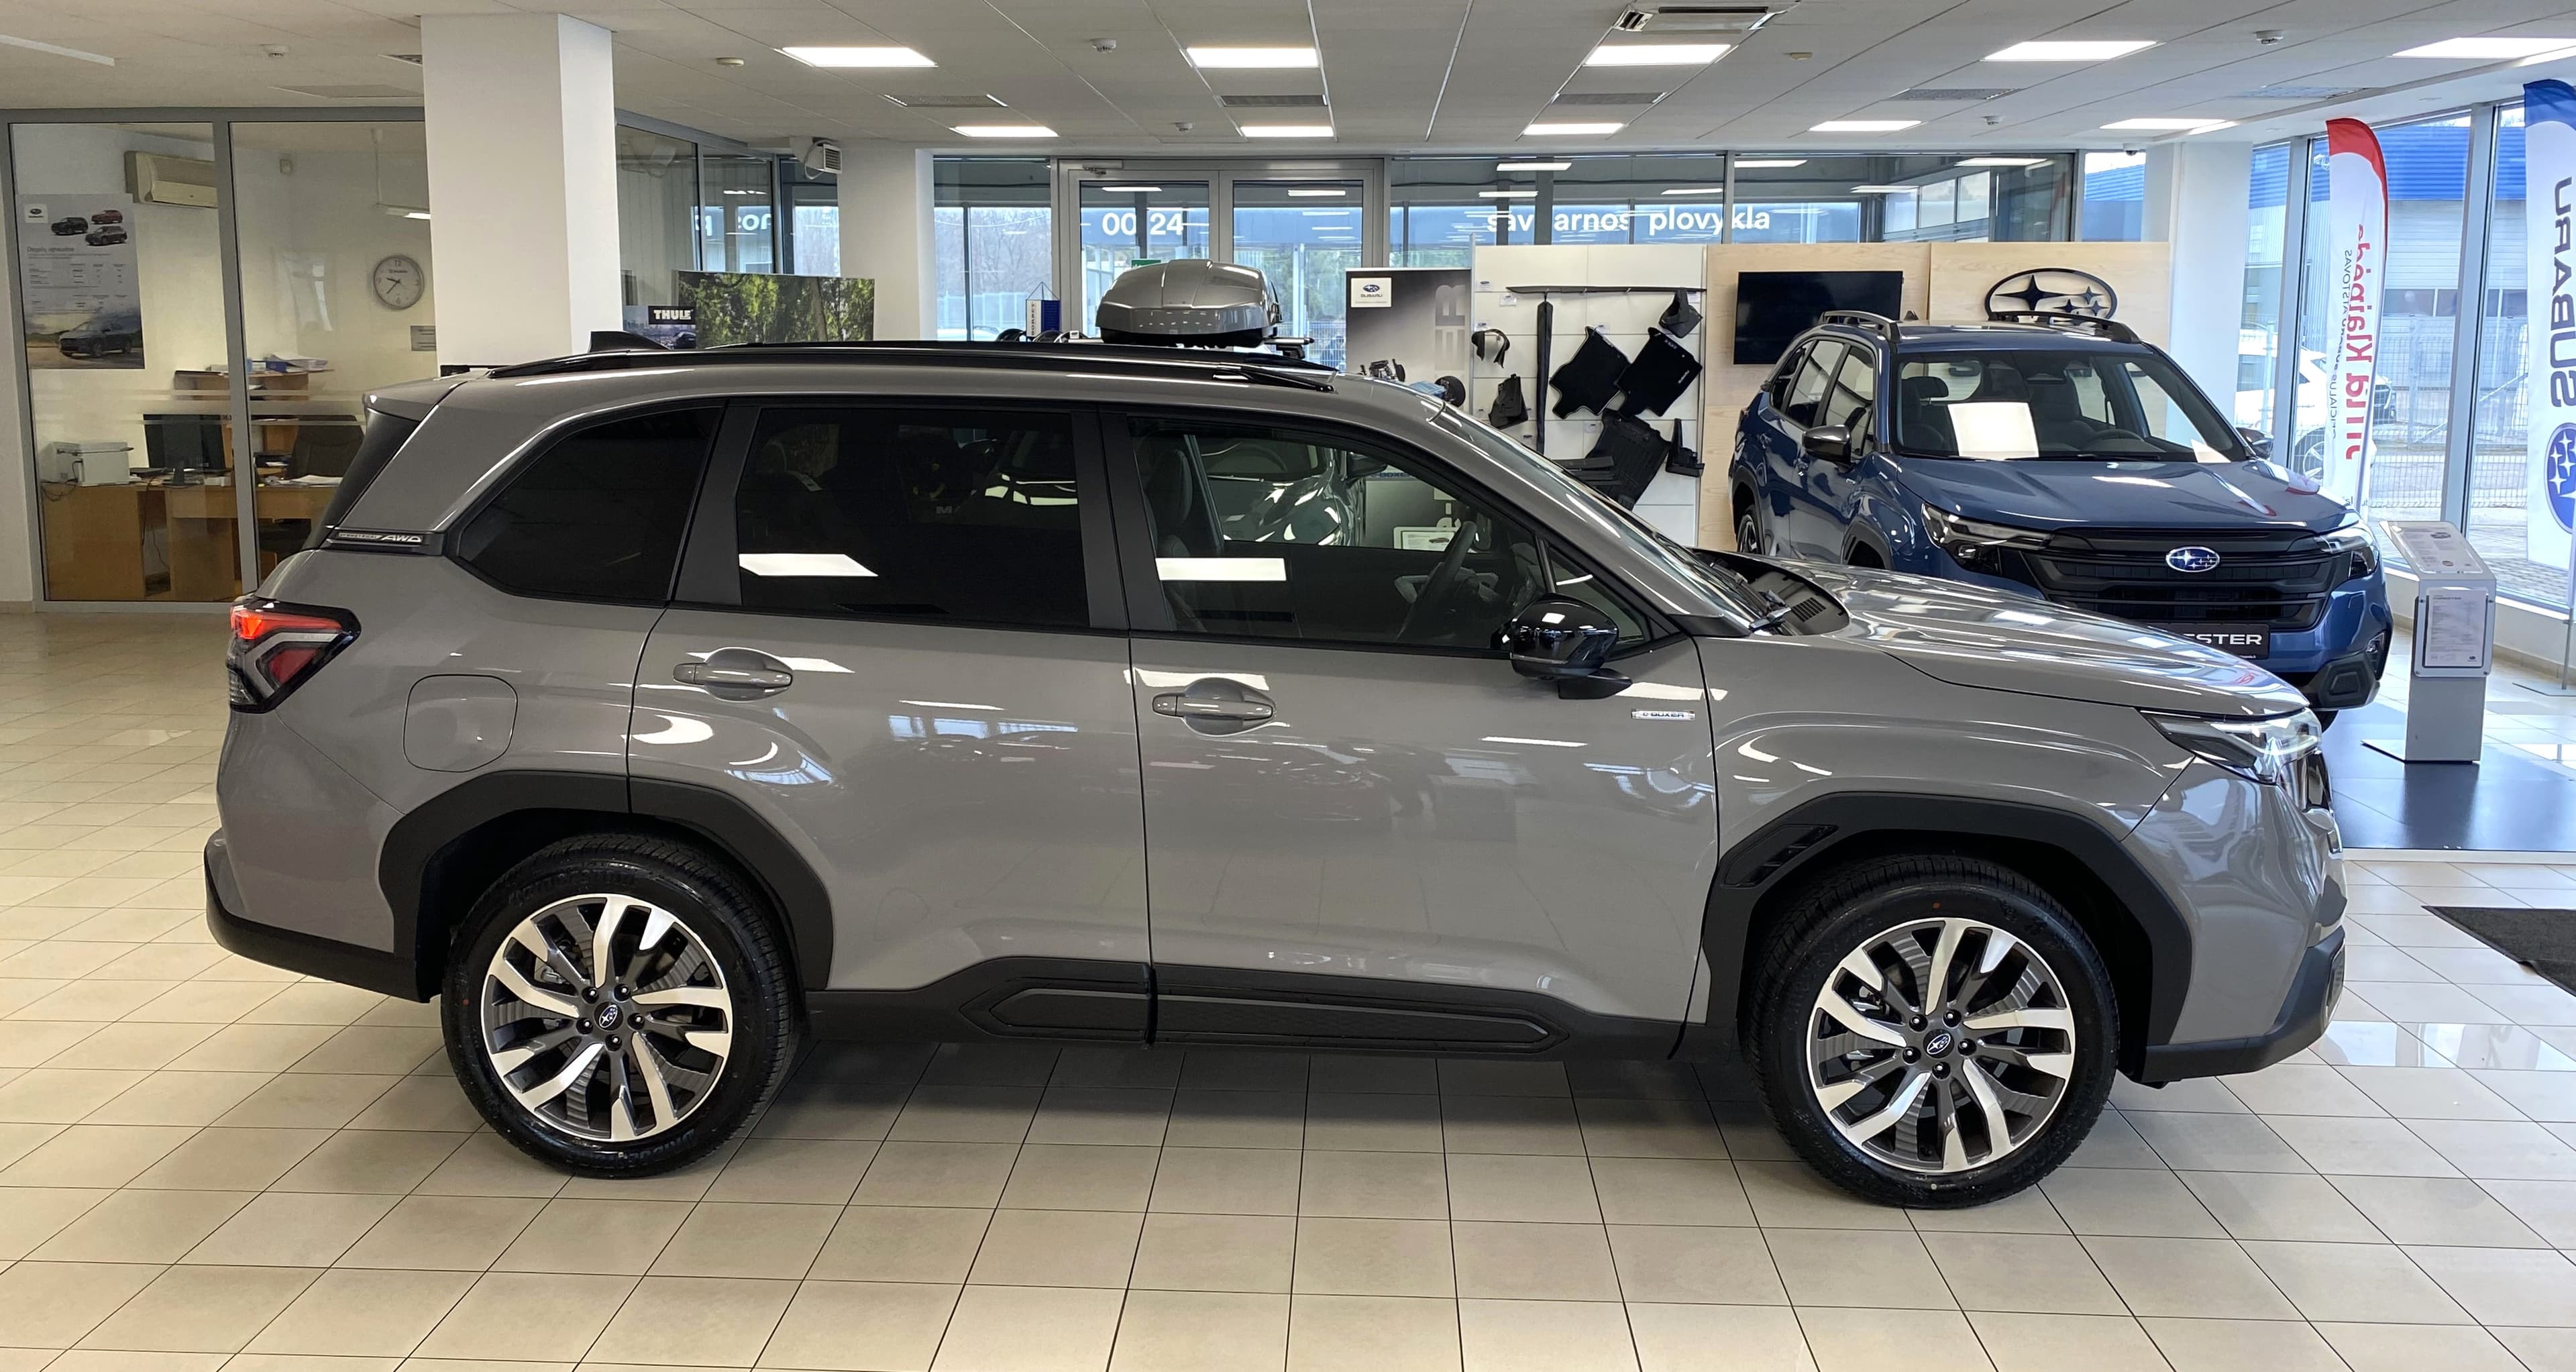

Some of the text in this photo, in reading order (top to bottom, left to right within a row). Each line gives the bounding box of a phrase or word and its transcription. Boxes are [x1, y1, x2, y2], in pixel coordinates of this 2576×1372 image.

[653, 309, 692, 320] THULE
[380, 534, 422, 543] AWD
[2184, 633, 2263, 645] STER
